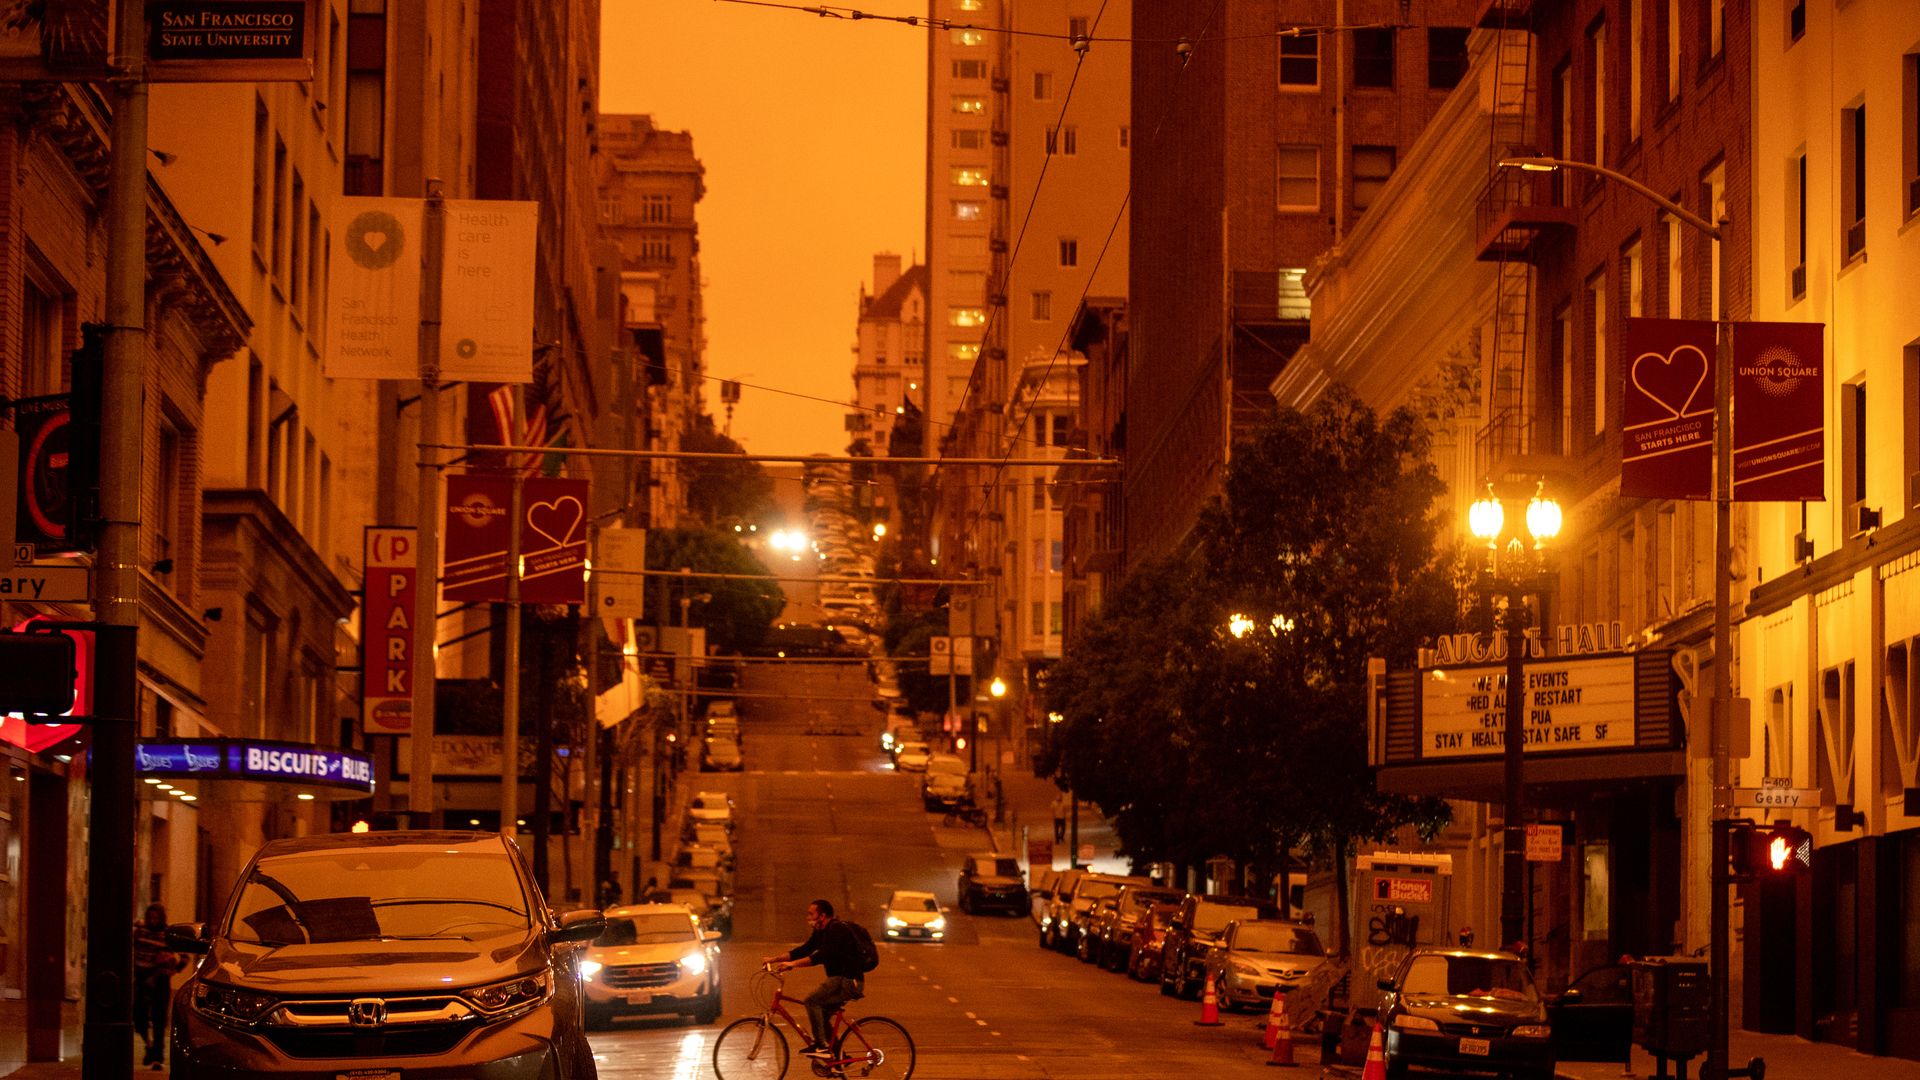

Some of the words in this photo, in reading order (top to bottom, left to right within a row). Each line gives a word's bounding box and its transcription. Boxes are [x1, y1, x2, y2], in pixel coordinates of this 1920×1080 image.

[162, 11, 195, 27] SAN
[201, 11, 294, 27] FRANCISCO
[162, 33, 202, 47] STATE
[207, 32, 292, 46] UNIVERSITY
[459, 212, 509, 226] Health
[459, 231, 491, 243] care
[458, 247, 469, 259] is
[458, 263, 491, 277] here
[341, 296, 366, 309] San
[341, 311, 398, 326] Francisco
[341, 328, 380, 341] Health
[340, 345, 392, 358] Network
[1739, 367, 1774, 376] UNION
[1777, 367, 1818, 378] SQUARE
[1634, 432, 1652, 443] SAN
[1653, 421, 1702, 438] FRANCISCO
[1640, 436, 1673, 450] STARTS
[1675, 431, 1701, 443] HERE
[0, 577, 46, 599] ary
[388, 573, 410, 692] PARK
[1435, 627, 1544, 665] AUGUT
[1557, 623, 1623, 656] HALL
[1476, 676, 1492, 692] WE
[1529, 672, 1568, 691] EVENTS
[1470, 695, 1490, 711] RED
[1534, 688, 1582, 707] RESTART
[1531, 709, 1552, 725] PUA
[1435, 733, 1462, 749] STAY
[1554, 727, 1581, 743] SAFE
[1595, 724, 1608, 740] SF
[247, 747, 328, 776] BISCUITS
[341, 756, 371, 783] BLUES
[1773, 777, 1790, 788] 400
[1755, 792, 1799, 807] Geary
[1391, 880, 1427, 893] Honey
[1391, 889, 1430, 901] Bucket
